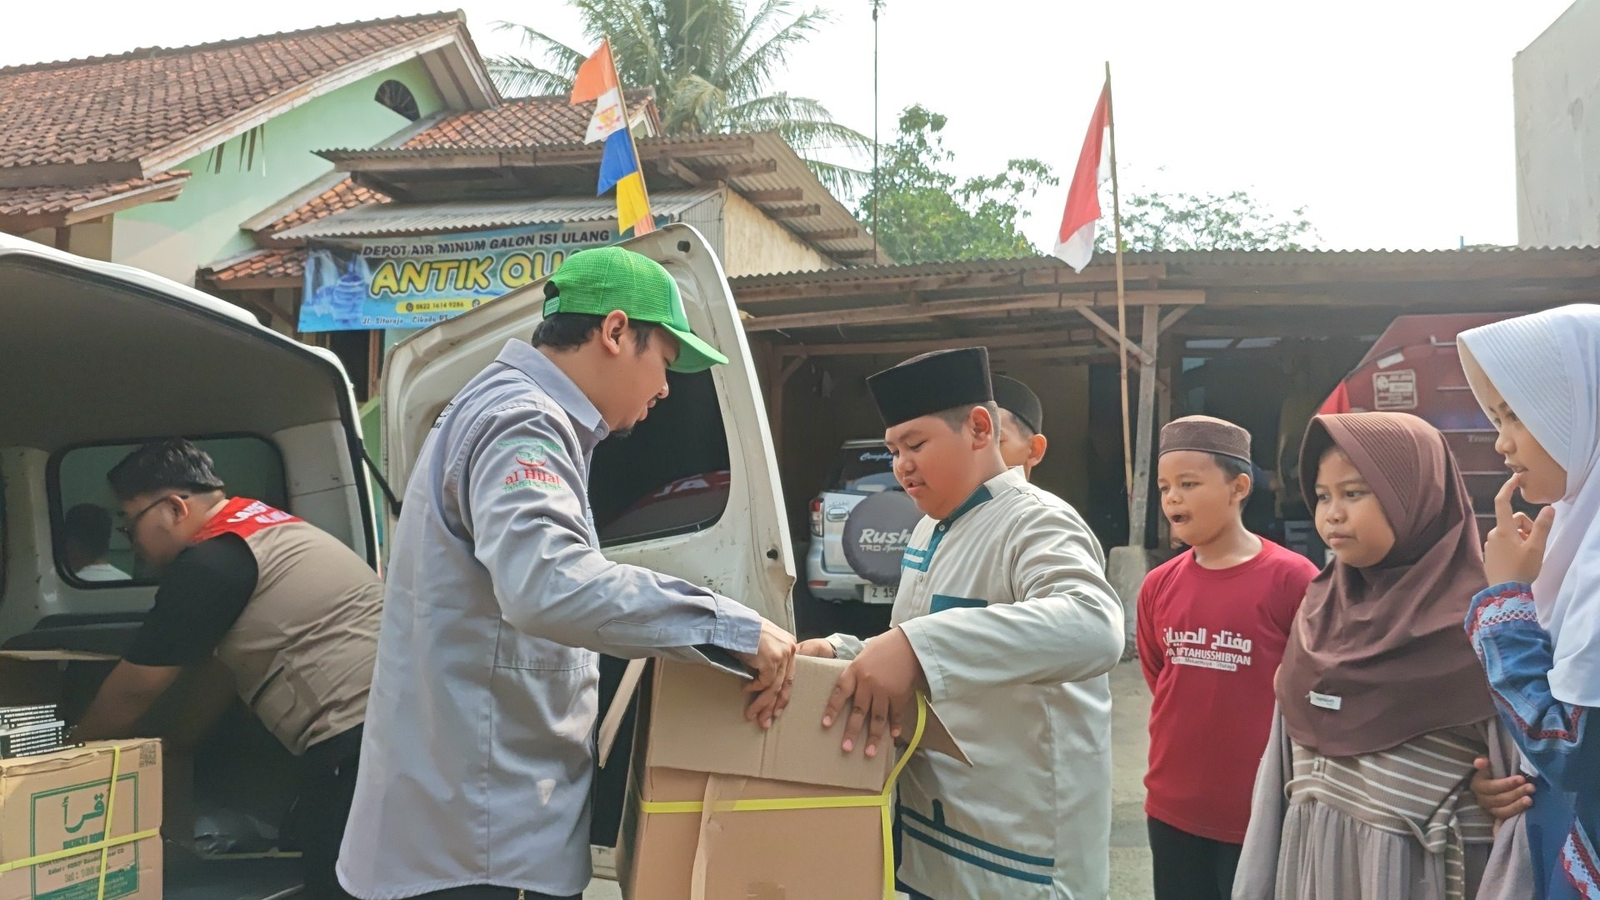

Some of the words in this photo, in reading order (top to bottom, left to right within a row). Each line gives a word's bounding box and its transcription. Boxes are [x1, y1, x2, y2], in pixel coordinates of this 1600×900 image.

[363, 245, 407, 256] DEPOT
[411, 244, 434, 255] AIR
[437, 240, 486, 253] MINUM
[489, 235, 535, 249] GALON
[539, 233, 557, 244] ISI
[561, 230, 610, 244] ULANG
[371, 256, 494, 295] ANTIK
[501, 250, 580, 288] QU
[859, 528, 911, 544] Rush
[872, 587, 878, 598] Z
